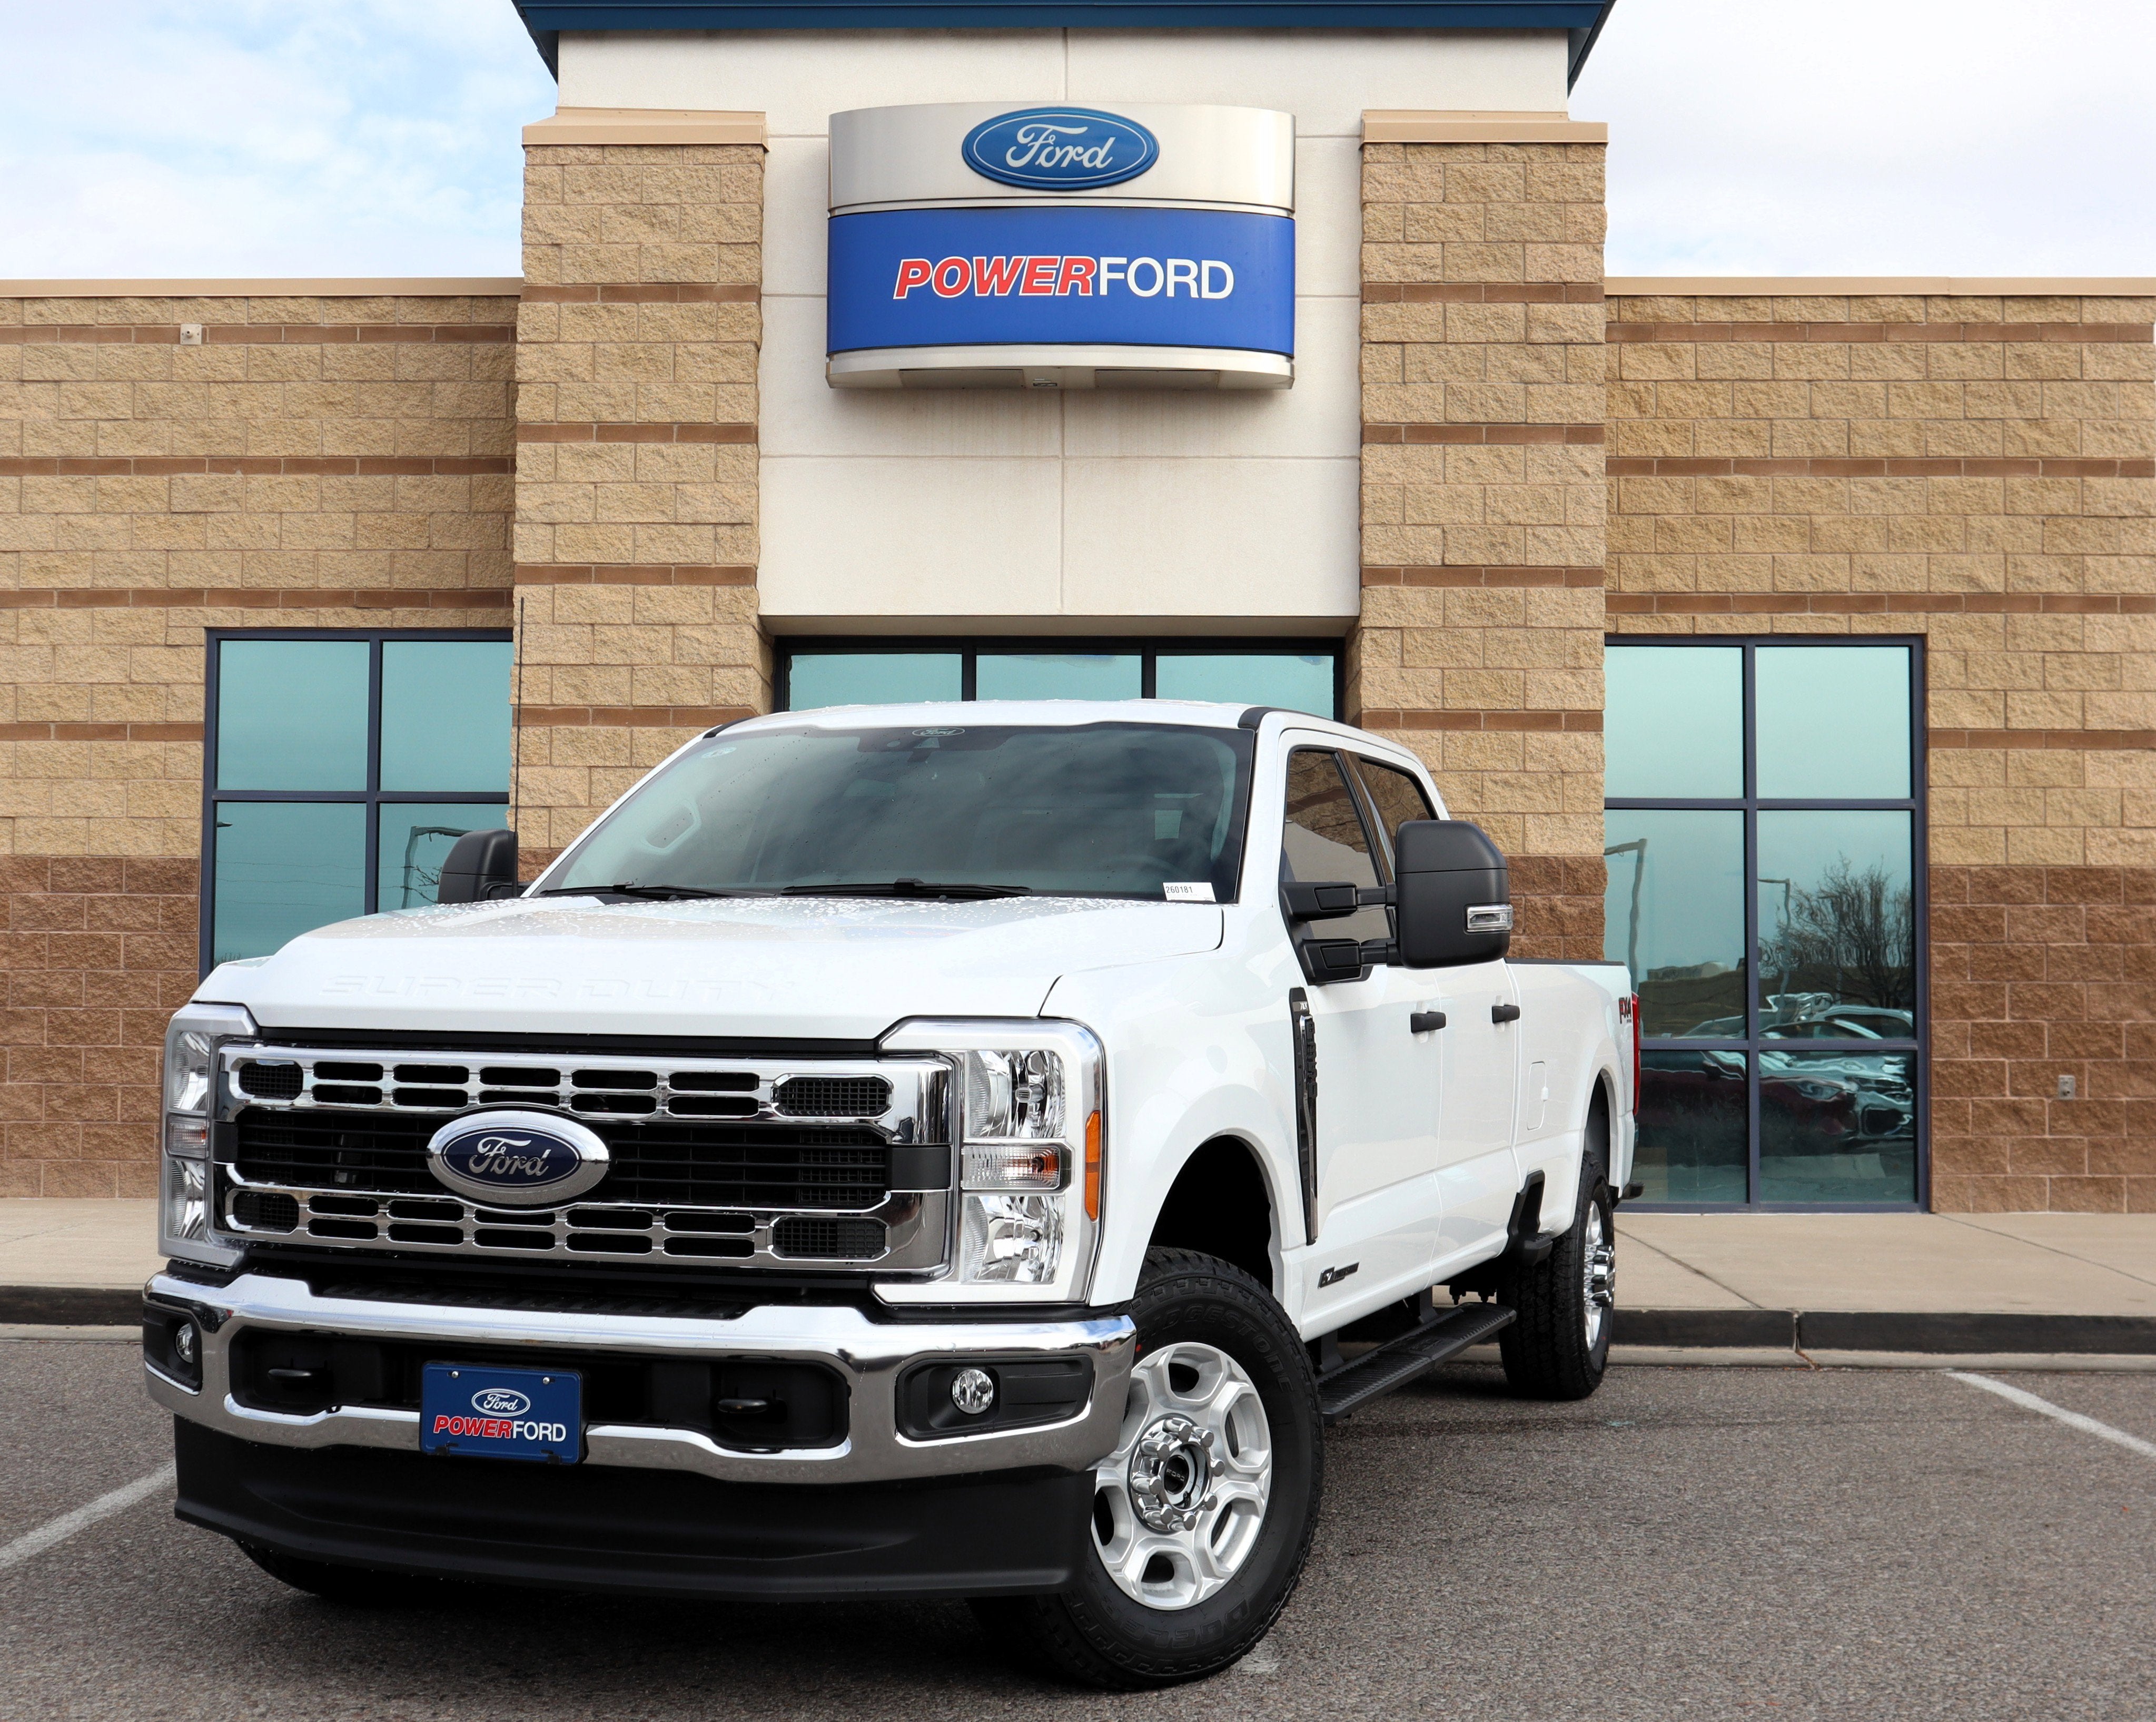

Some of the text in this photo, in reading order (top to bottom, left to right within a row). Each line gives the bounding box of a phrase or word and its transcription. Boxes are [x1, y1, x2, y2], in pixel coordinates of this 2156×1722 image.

[1006, 123, 1116, 169] Ford
[319, 975, 795, 1002] SUPER DUTY
[469, 1136, 552, 1176] Ford
[1136, 1303, 1294, 1393] RIDGESTONE
[483, 1393, 519, 1411] Ford
[1166, 1468, 1185, 1482] FORD
